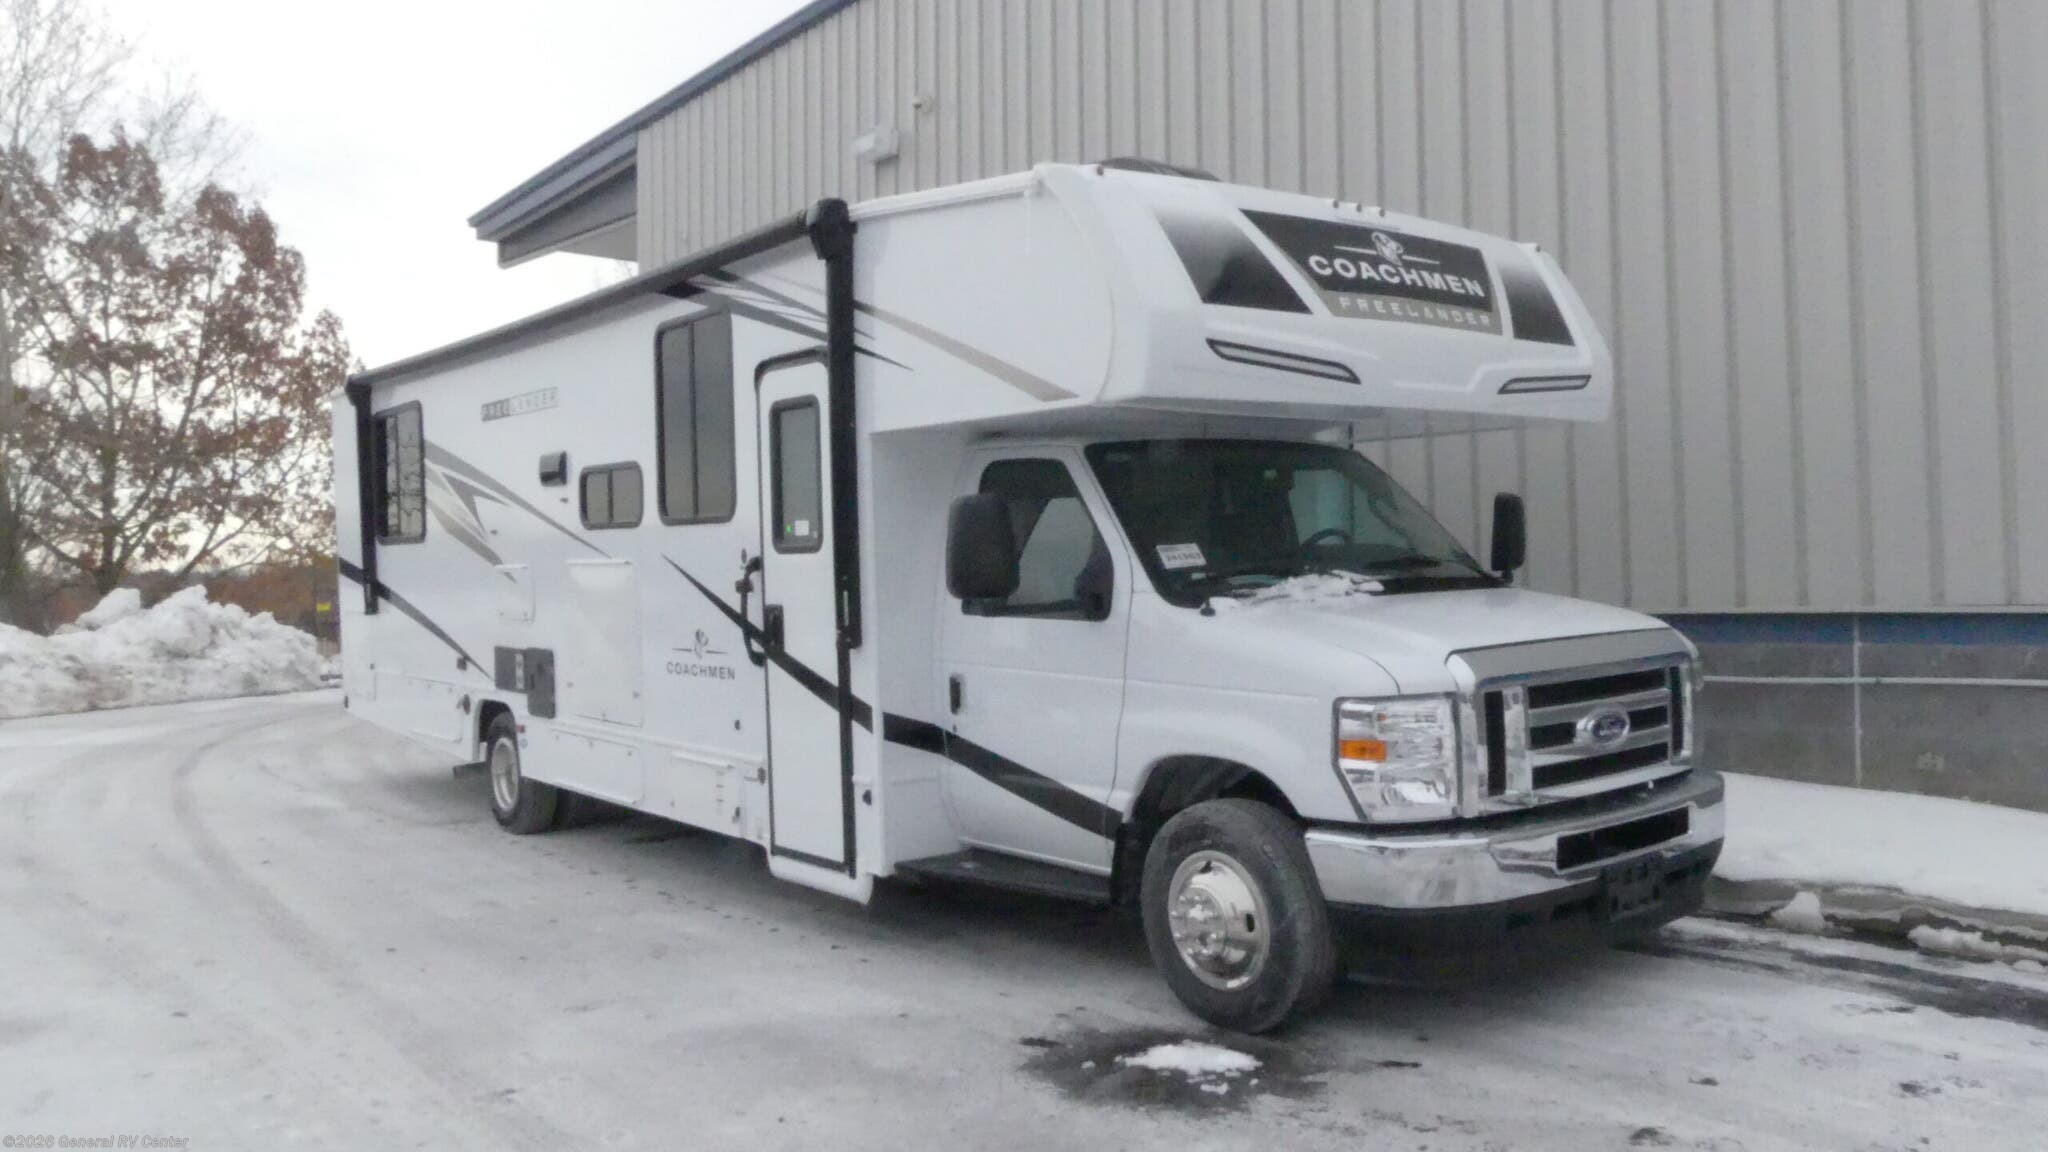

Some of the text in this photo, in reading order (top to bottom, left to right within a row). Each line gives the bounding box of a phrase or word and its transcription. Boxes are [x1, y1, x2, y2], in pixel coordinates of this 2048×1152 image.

[1309, 255, 1484, 297] COACHMEN
[1339, 297, 1490, 326] FREELANDER
[666, 662, 735, 680] COACHMEN
